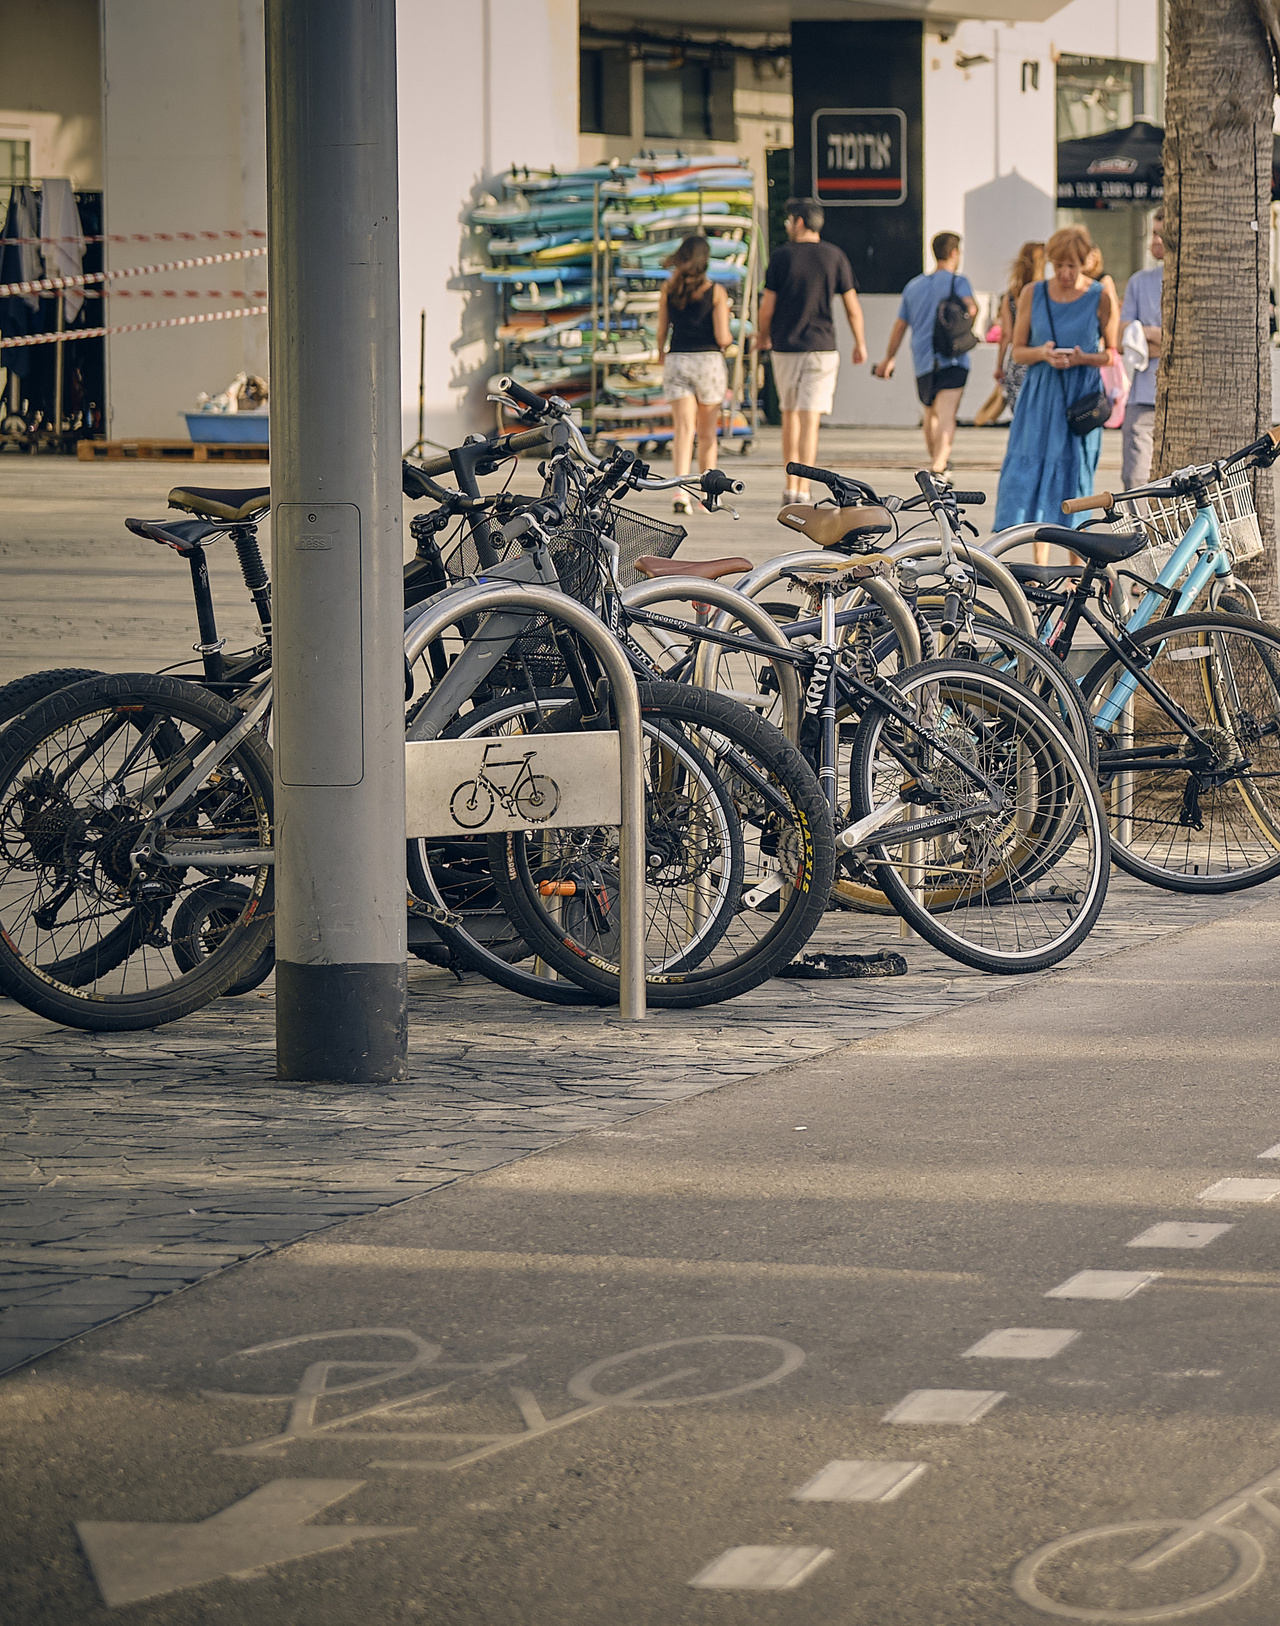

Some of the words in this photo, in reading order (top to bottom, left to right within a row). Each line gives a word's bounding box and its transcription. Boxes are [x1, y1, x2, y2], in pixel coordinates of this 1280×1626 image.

[827, 132, 892, 170] ארומה
[646, 611, 689, 630] discovery
[798, 809, 813, 894] MAXXIS
[587, 956, 620, 976] SINGL
[645, 974, 669, 984] ACK
[53, 980, 89, 999] TRACK
